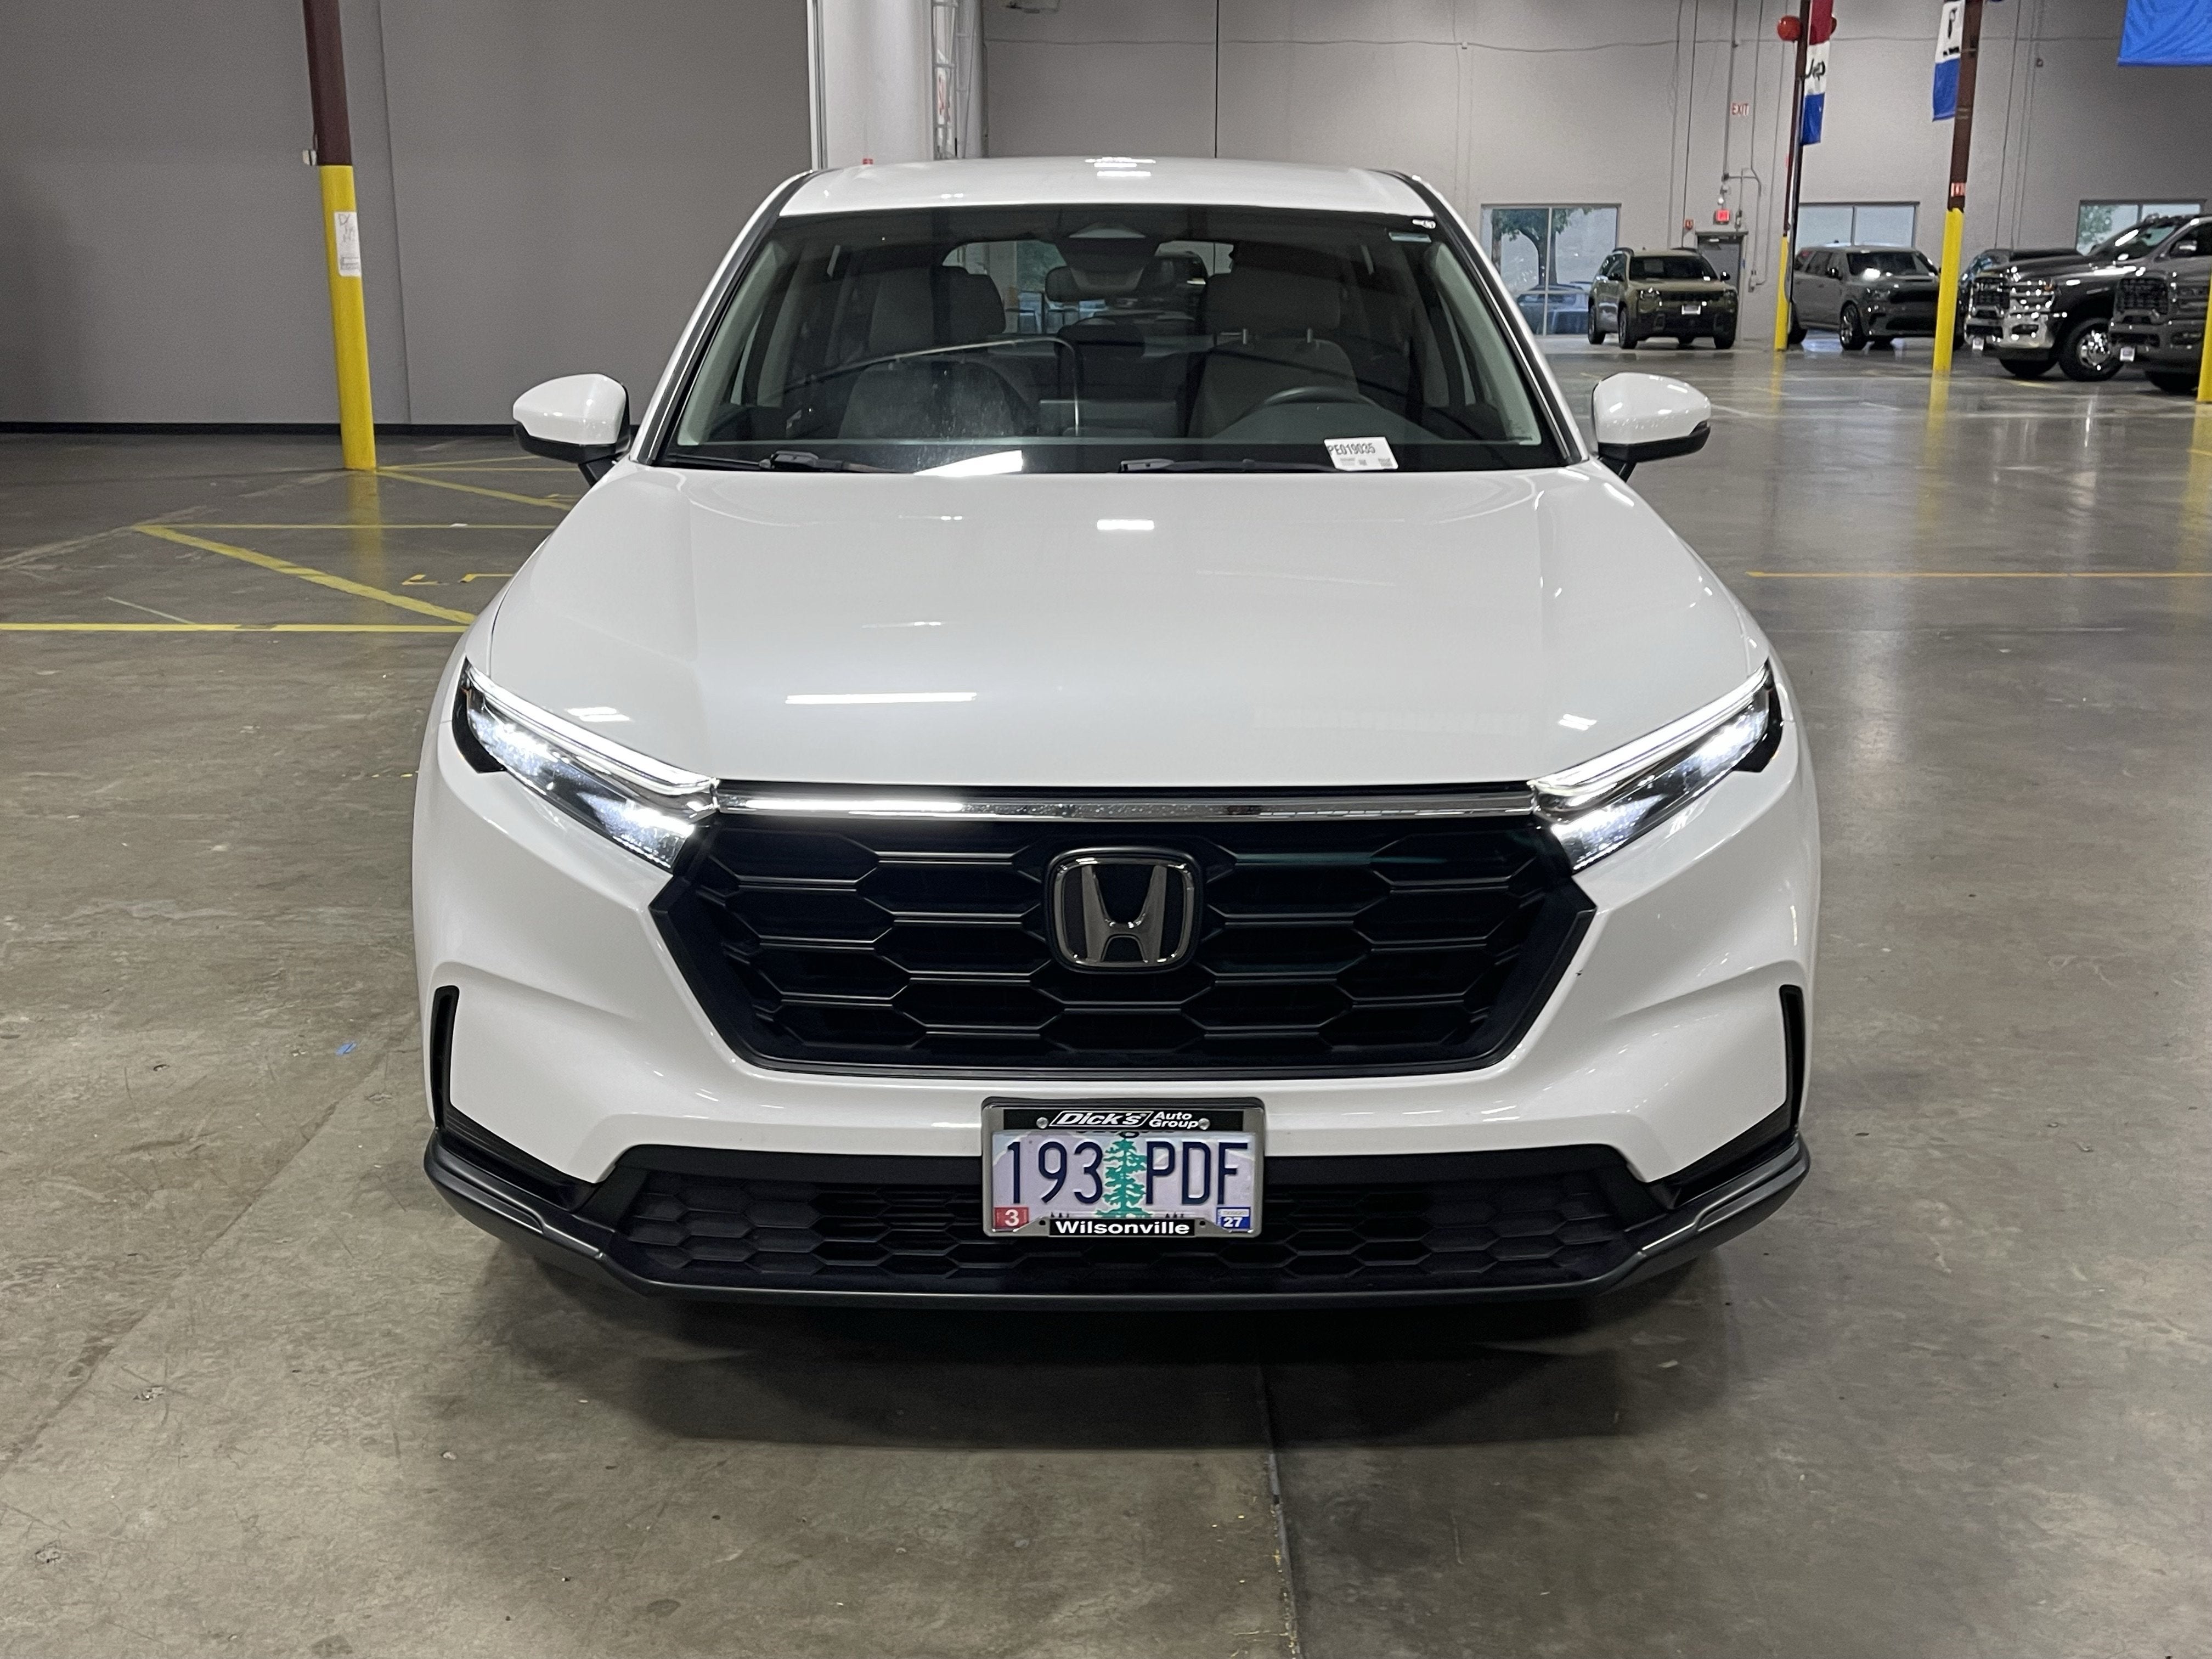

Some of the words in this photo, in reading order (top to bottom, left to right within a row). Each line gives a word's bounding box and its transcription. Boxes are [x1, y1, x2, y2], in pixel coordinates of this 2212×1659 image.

[1731, 103, 1748, 115] EXIT
[1153, 1111, 1192, 1120] Auto
[1149, 1119, 1200, 1129] Group
[1007, 1141, 1103, 1204] 193
[1146, 1141, 1248, 1204] PDF
[1005, 1209, 1019, 1227] 3
[1223, 1217, 1243, 1227] 27
[1056, 1221, 1190, 1234] Wilsonville
